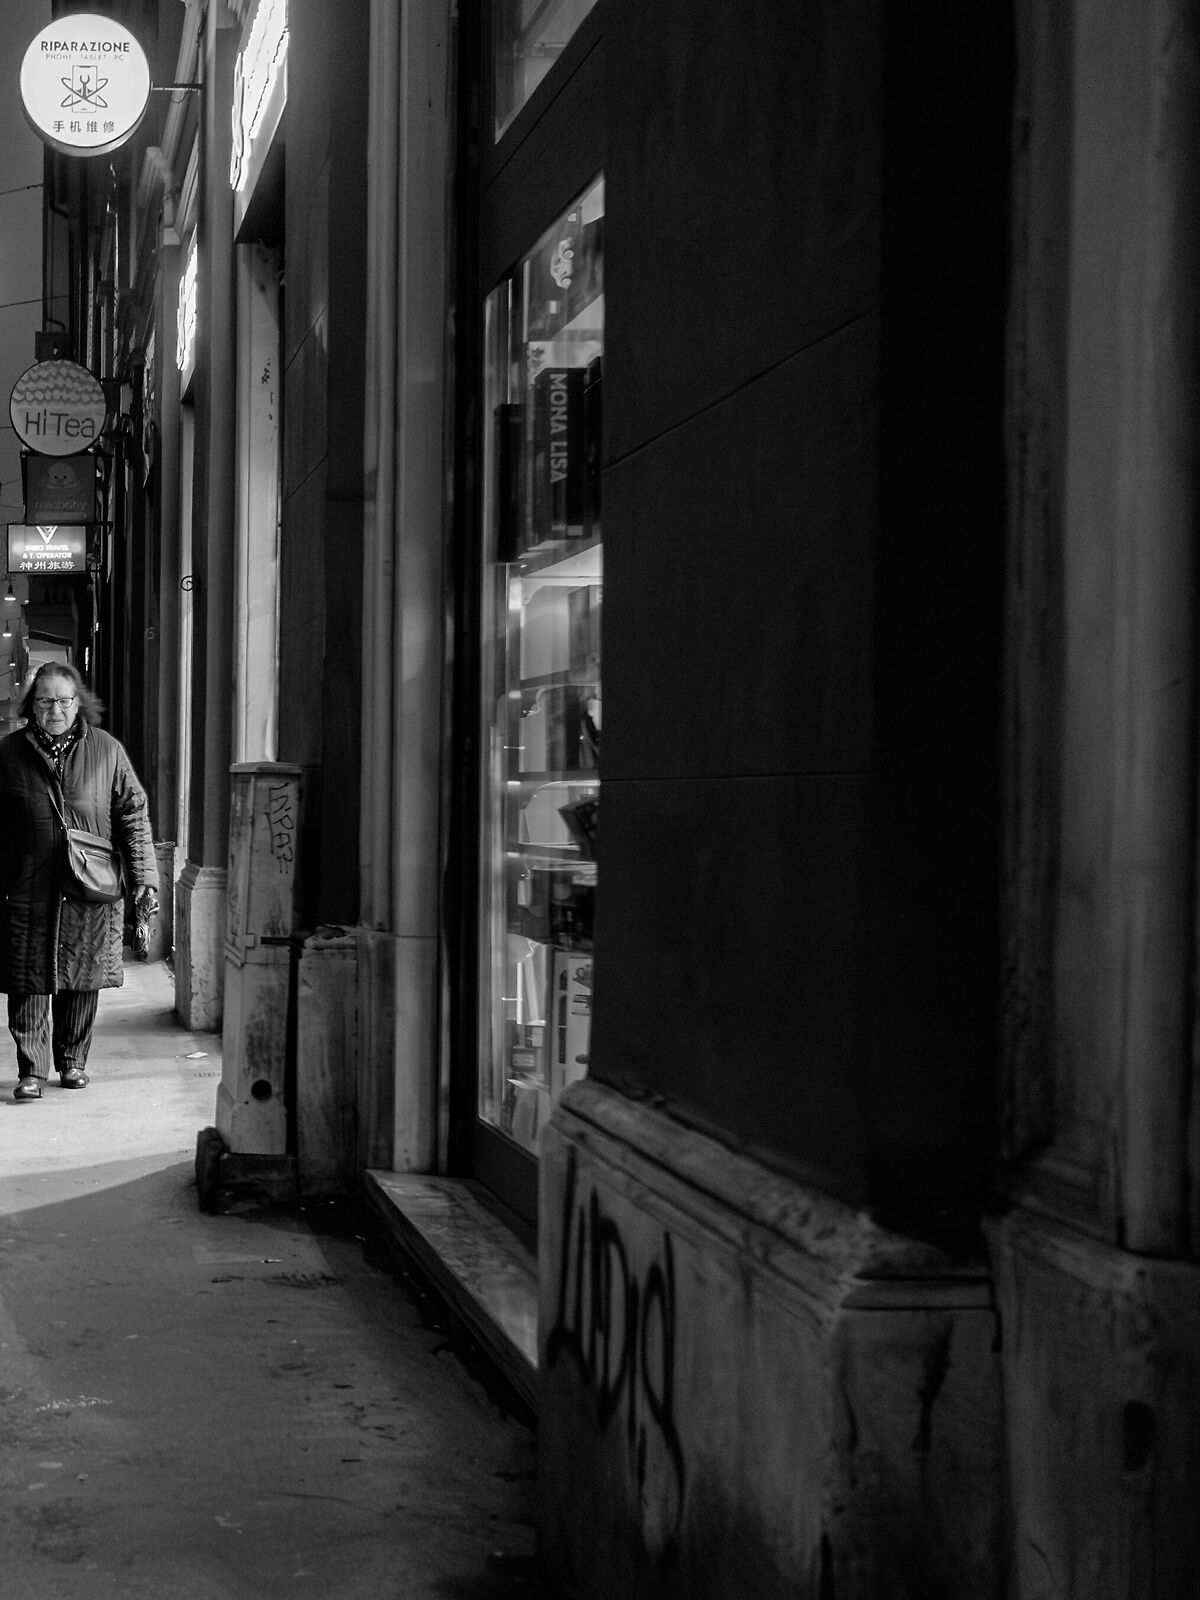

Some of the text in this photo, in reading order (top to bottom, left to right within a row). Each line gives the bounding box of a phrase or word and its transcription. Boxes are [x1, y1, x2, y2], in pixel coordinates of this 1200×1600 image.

[40, 41, 130, 52] RIPARAZIONE
[53, 120, 115, 133] 手机维修
[549, 373, 569, 484] MONA LISA
